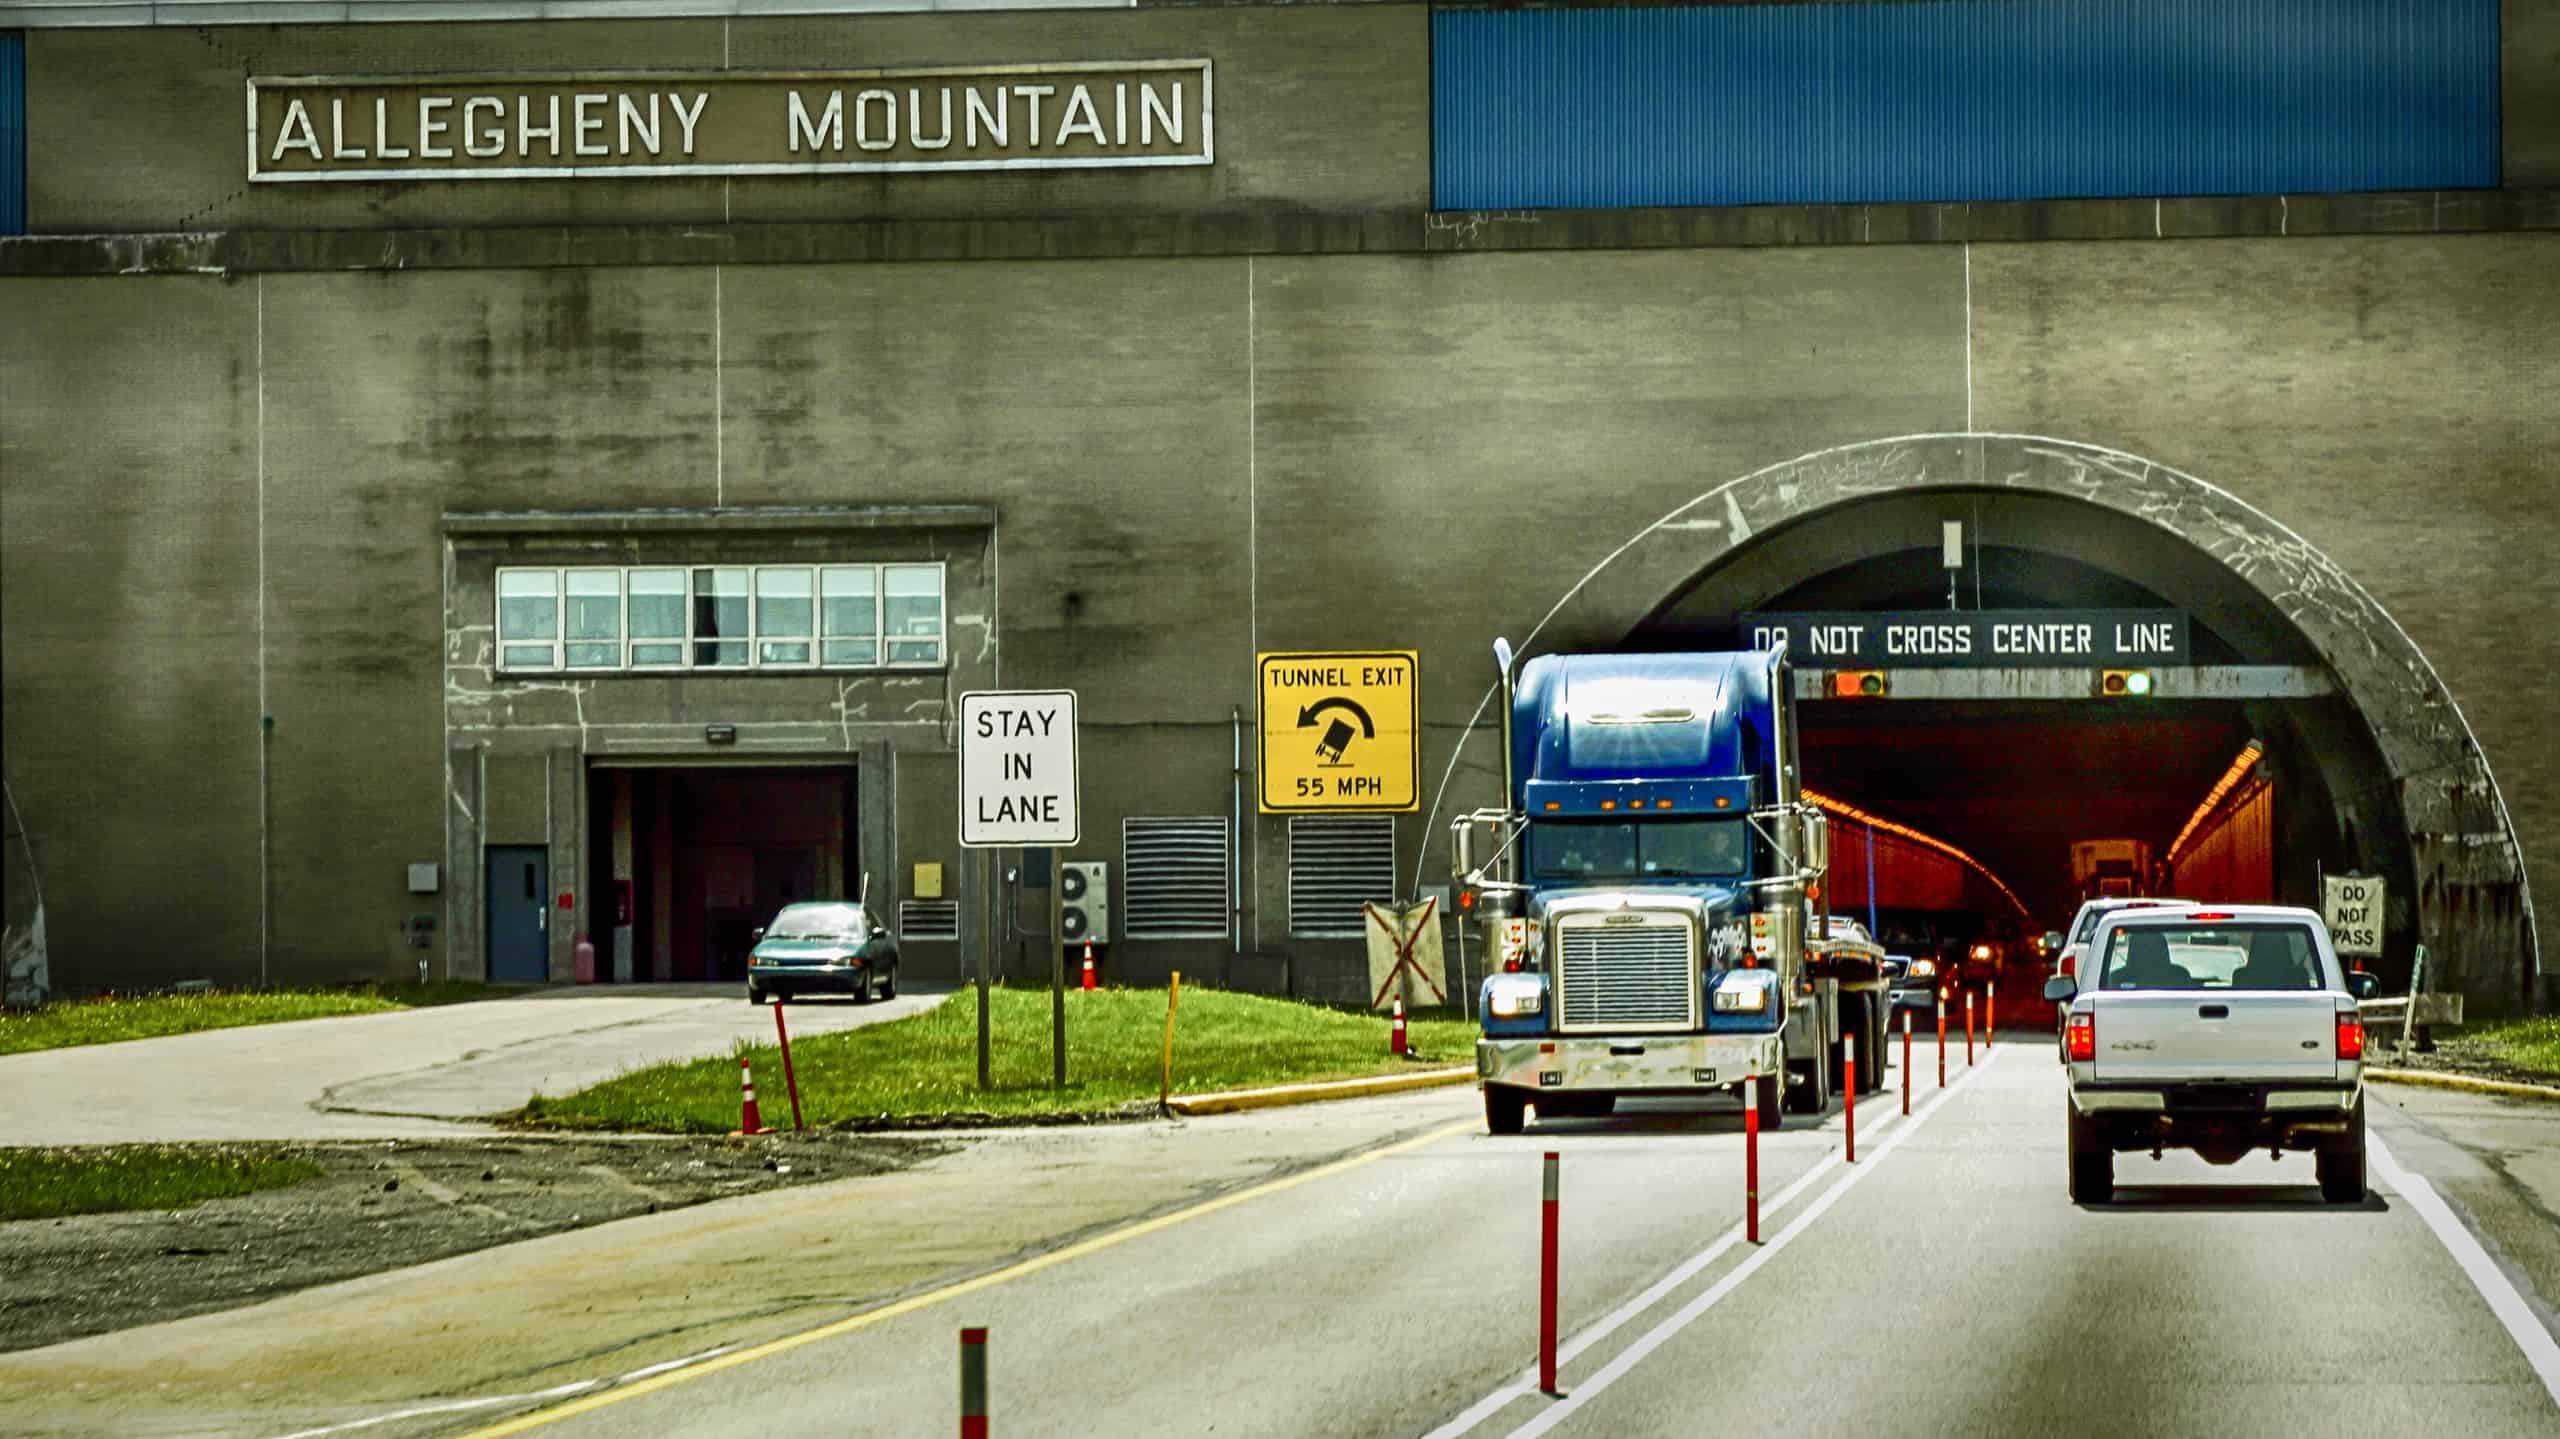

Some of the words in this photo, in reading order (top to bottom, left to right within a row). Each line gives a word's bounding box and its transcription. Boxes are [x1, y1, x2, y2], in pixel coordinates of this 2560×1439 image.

[271, 92, 709, 161] ALLEGHENY
[788, 82, 1185, 152] MOUNTAIN
[1811, 626, 1863, 654] NOT
[1887, 626, 1971, 654] CROSS
[1993, 625, 2092, 653] CENTER
[2116, 624, 2175, 653] LINE
[1270, 668, 1351, 687] TUNNEL
[1362, 667, 1405, 686] EXIT
[977, 710, 1057, 738] STAY
[1003, 754, 1032, 780] IN
[1296, 778, 1325, 797] 55
[1337, 777, 1382, 797] MPH
[978, 795, 1060, 823] LANE
[2343, 886, 2365, 901] DO
[2338, 908, 2369, 923] NOT
[2333, 929, 2374, 946] PASS
